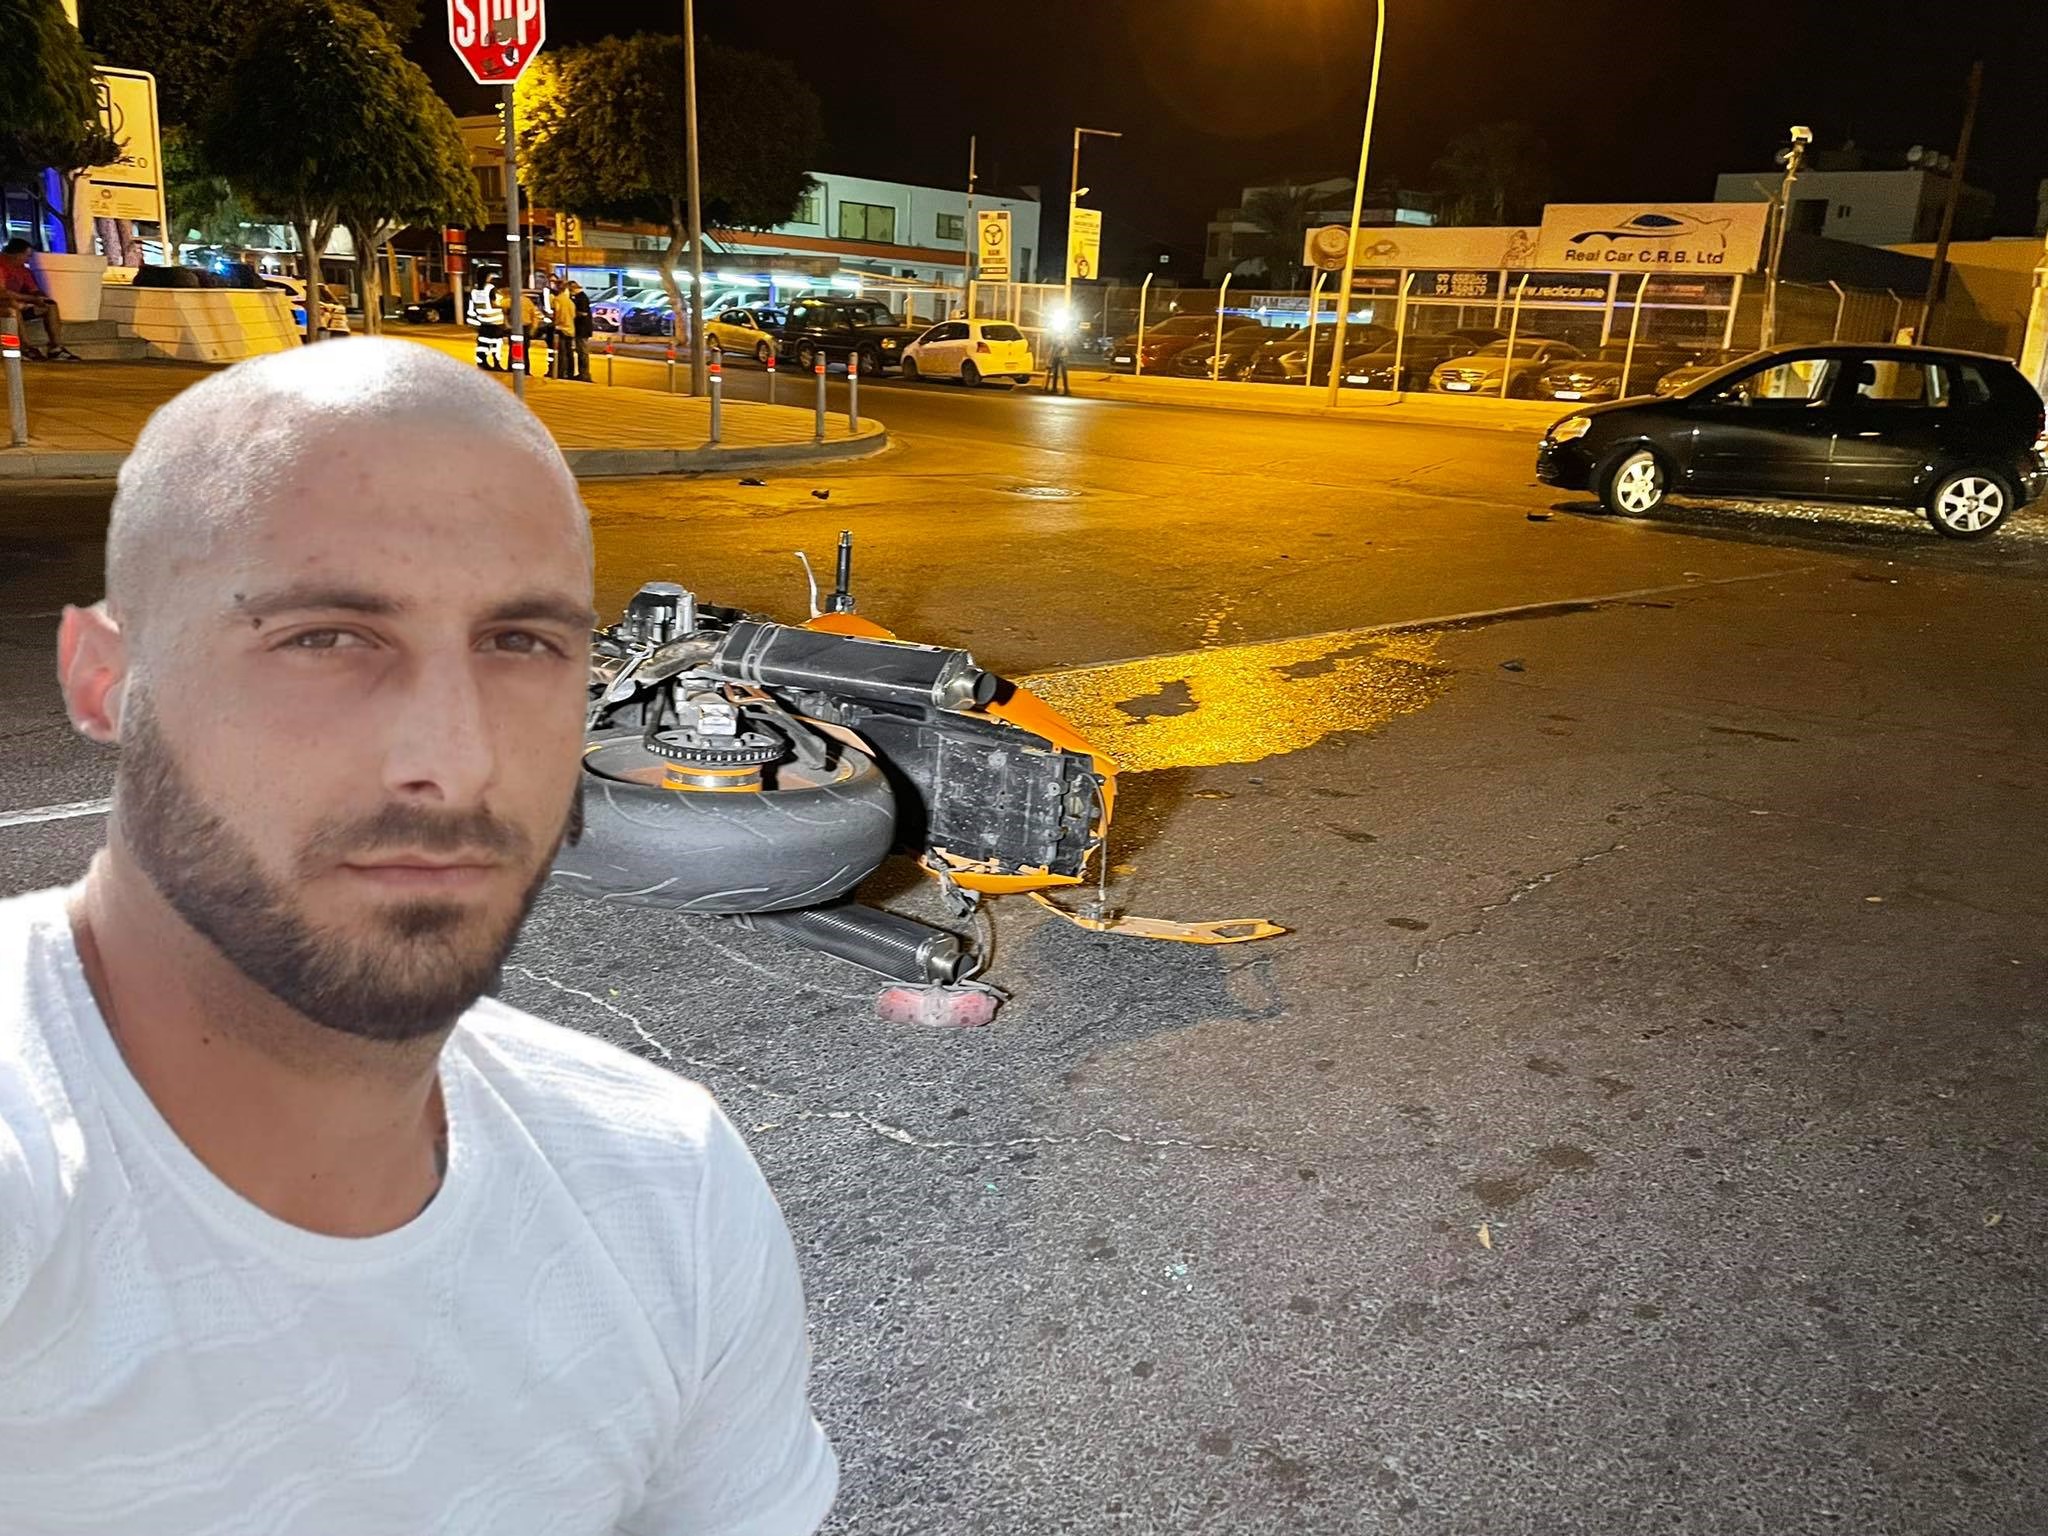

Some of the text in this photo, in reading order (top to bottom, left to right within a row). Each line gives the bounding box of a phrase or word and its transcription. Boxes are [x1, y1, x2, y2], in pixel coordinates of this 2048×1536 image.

[1564, 249, 1725, 264] Real Car C.R.B. Ltd
[1436, 273, 1450, 284] 99
[1435, 284, 1449, 295] 99
